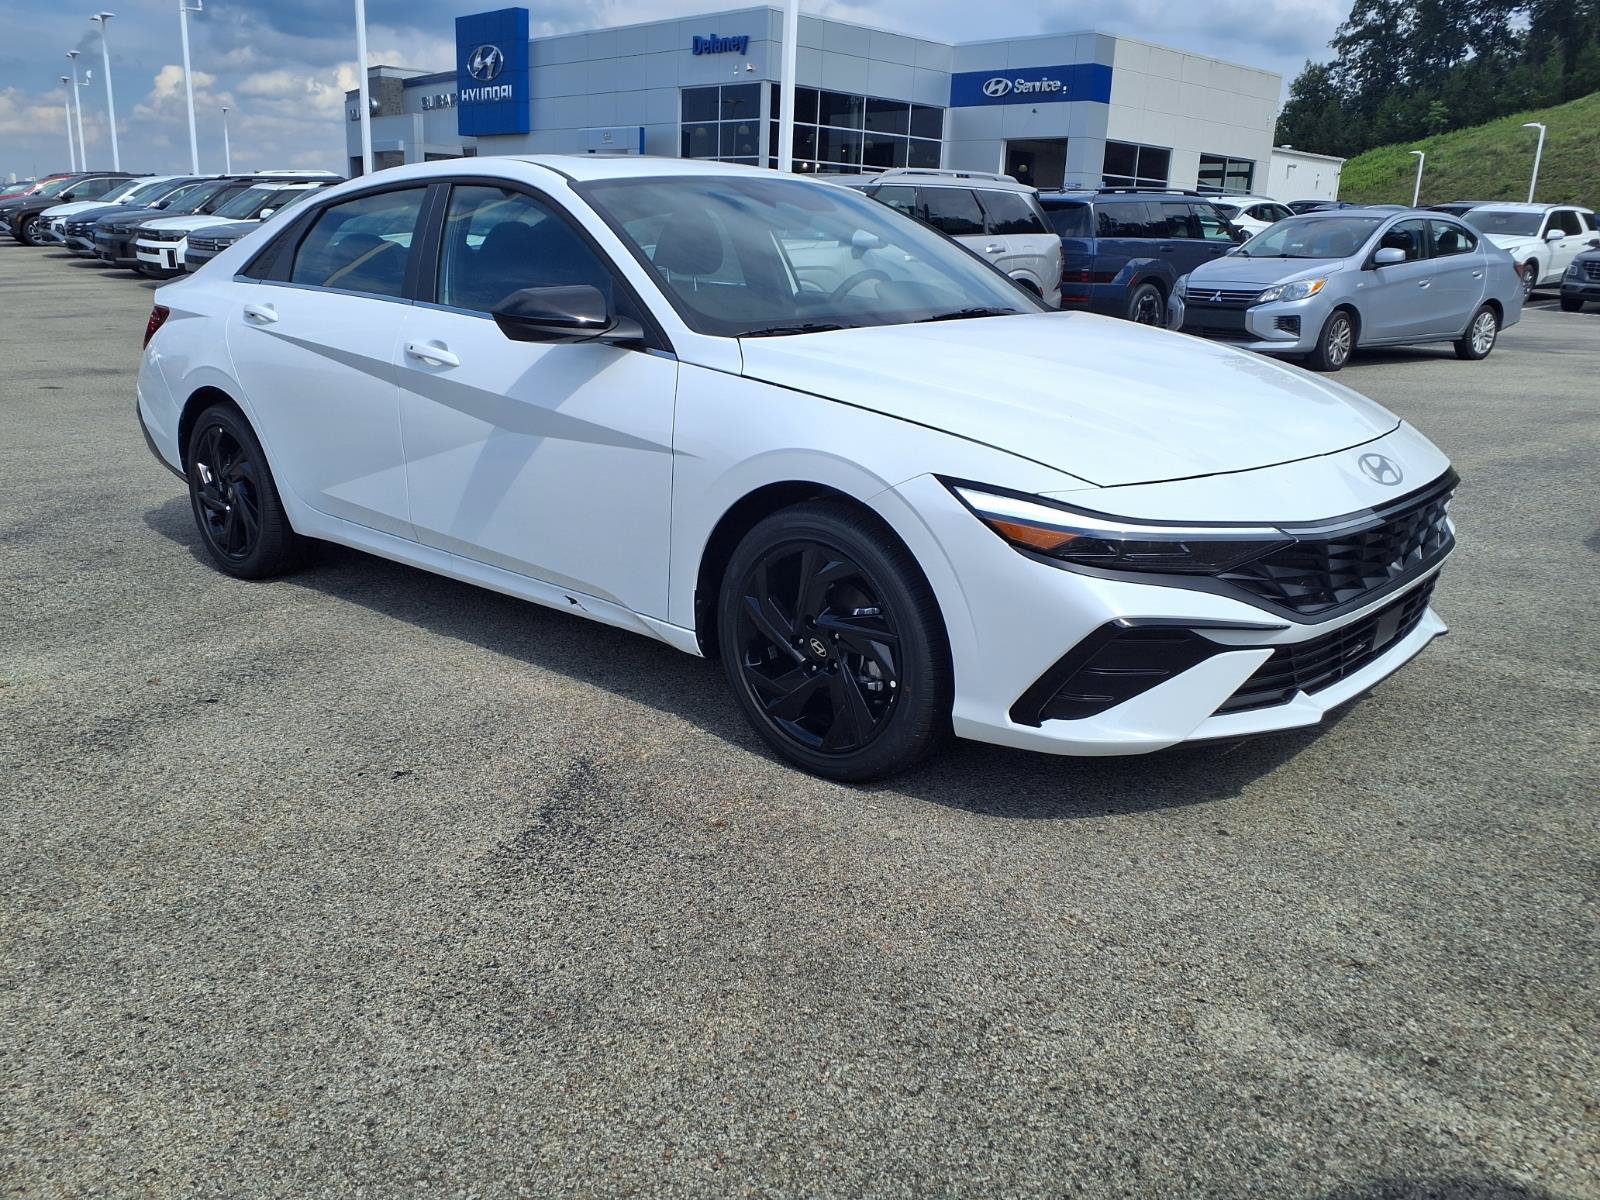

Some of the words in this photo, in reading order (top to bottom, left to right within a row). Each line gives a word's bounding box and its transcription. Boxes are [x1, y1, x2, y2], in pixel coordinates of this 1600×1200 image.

[692, 33, 749, 56] Delaney
[461, 84, 512, 101] HYUNDAI
[1013, 77, 1061, 94] Service
